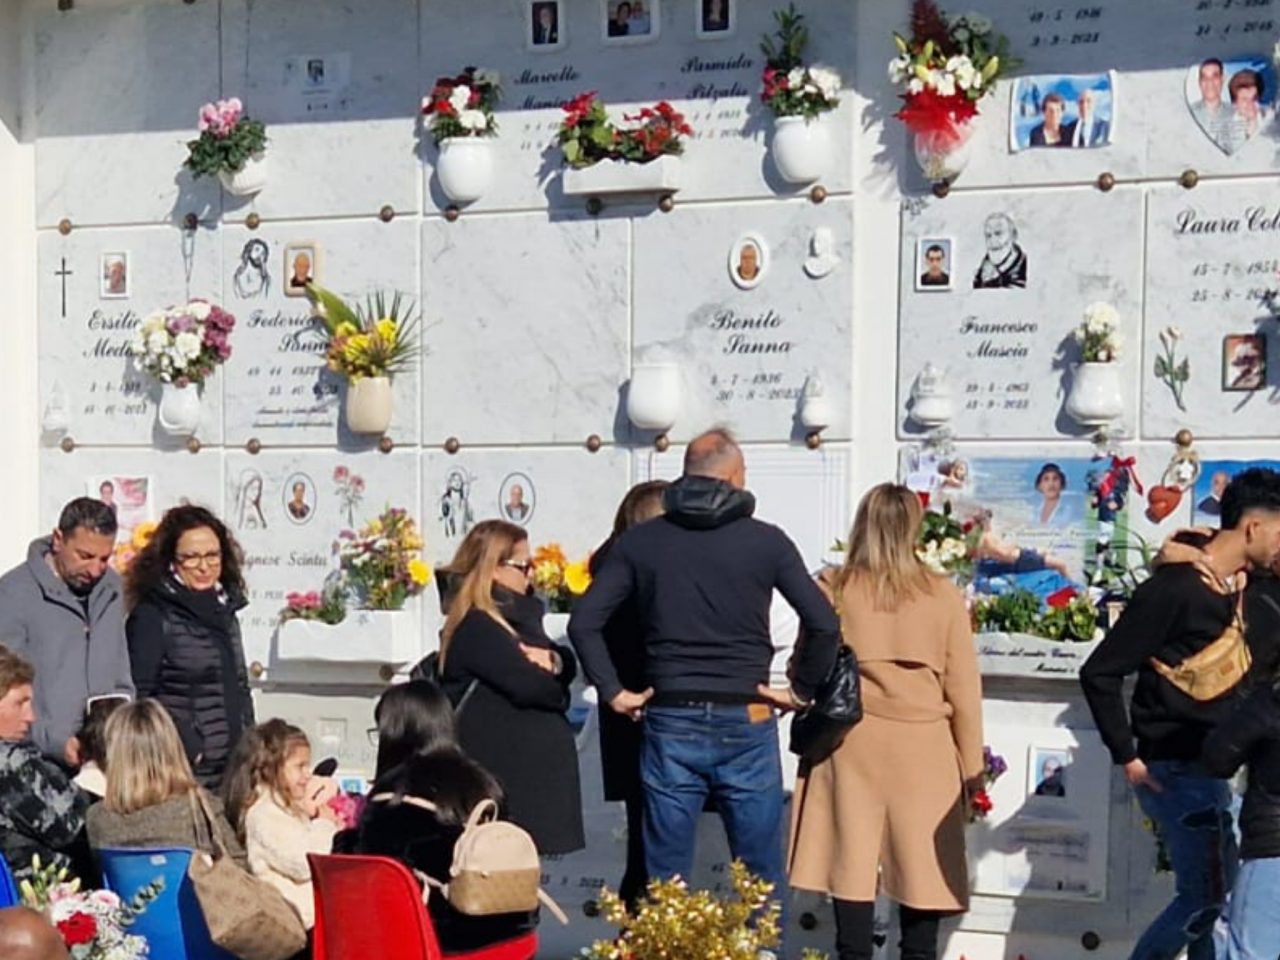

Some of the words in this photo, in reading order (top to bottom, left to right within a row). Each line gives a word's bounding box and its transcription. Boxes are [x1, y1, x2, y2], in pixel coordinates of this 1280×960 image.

[513, 65, 580, 85] Marcello
[1173, 207, 1240, 235] Laura
[709, 309, 783, 330] Benito
[959, 315, 1038, 334] Francesco
[723, 333, 796, 354] Sanna
[966, 339, 1029, 359] Mascia
